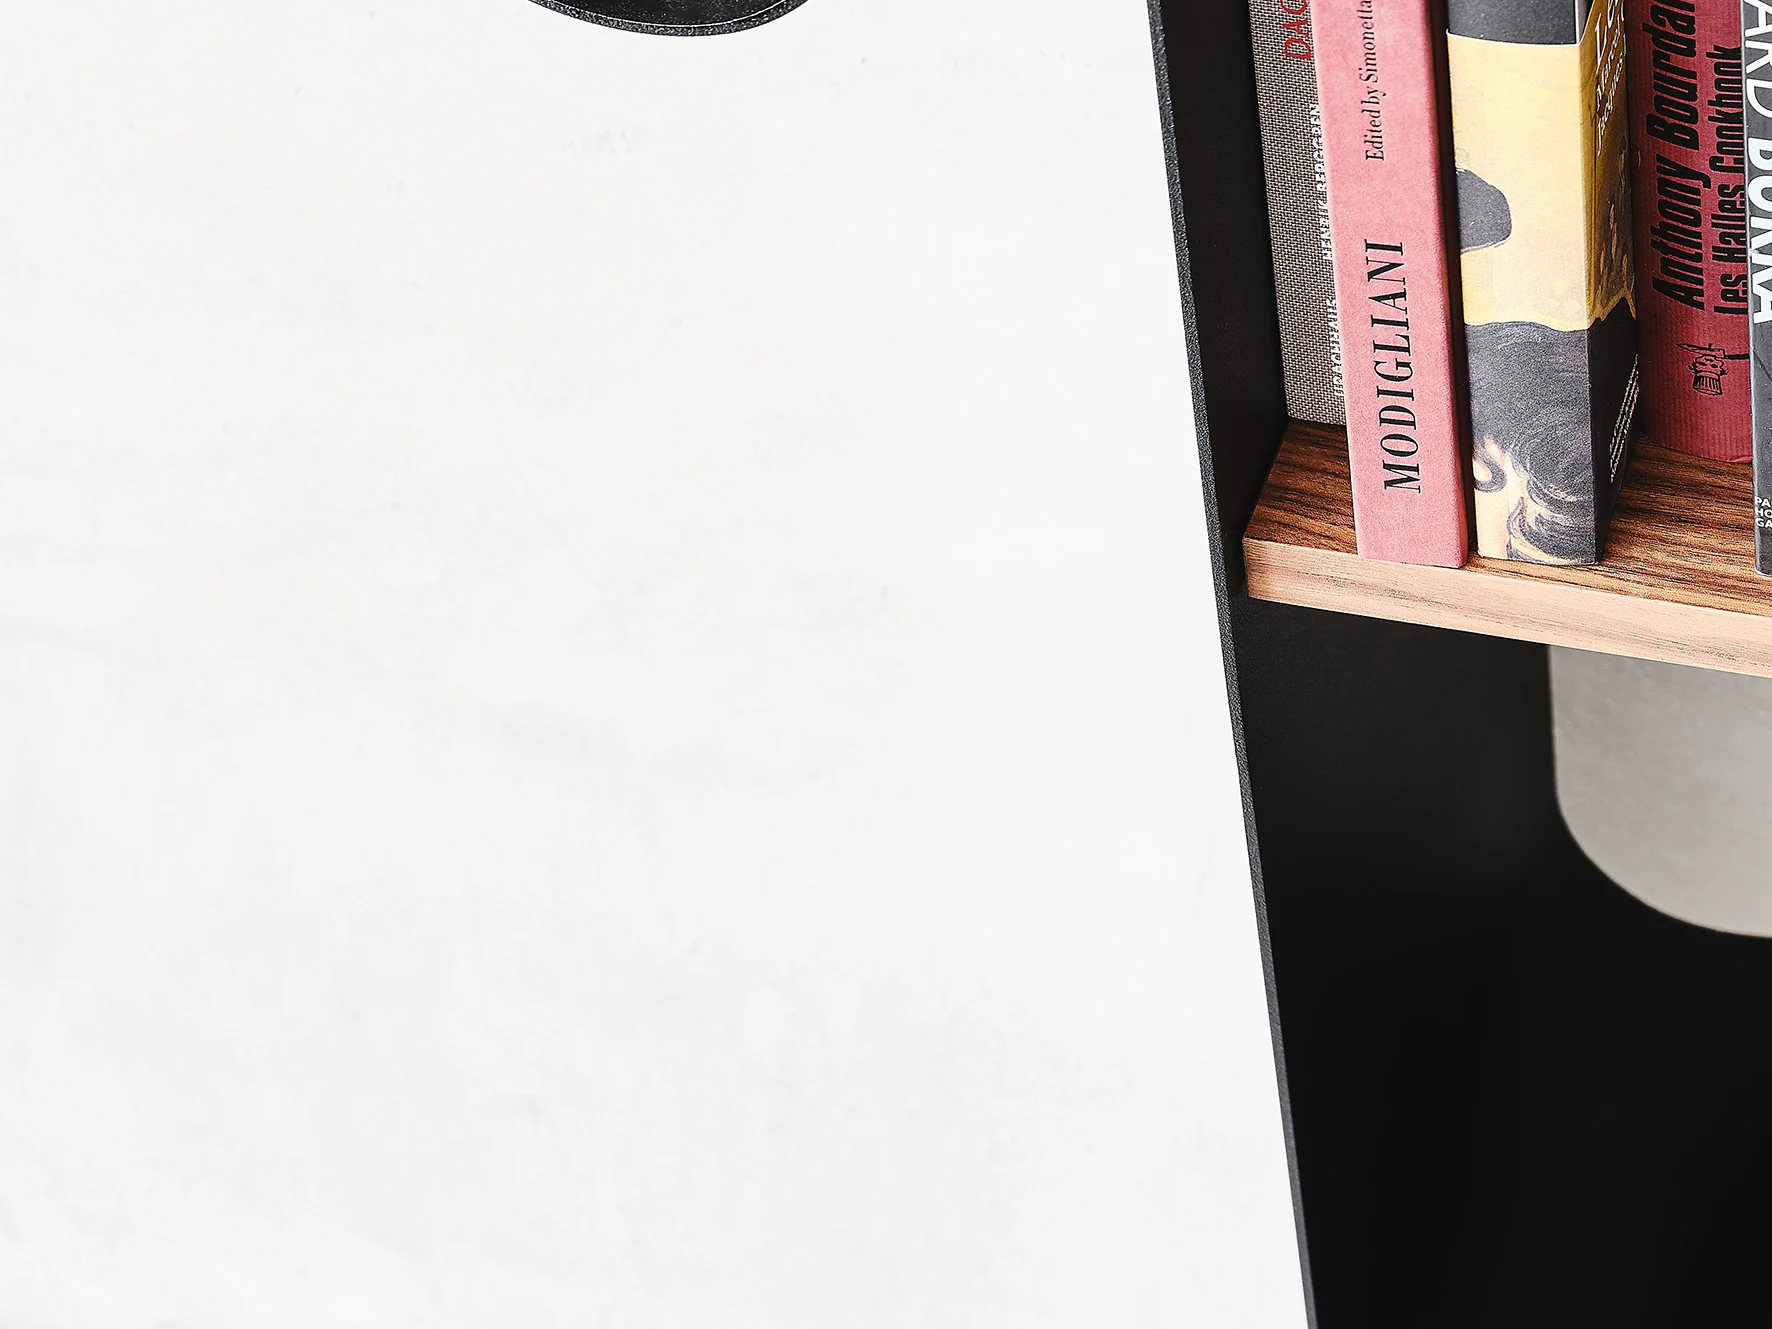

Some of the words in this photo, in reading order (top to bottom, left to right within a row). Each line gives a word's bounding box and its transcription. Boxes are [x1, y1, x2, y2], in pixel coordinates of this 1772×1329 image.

[1356, 0, 1379, 83] Simonetta
[1361, 84, 1387, 105] by
[1362, 106, 1385, 161] Edited
[1706, 44, 1745, 174] Cookbook
[1650, 154, 1711, 312] Anthony
[1710, 183, 1747, 265] Halles
[1713, 274, 1748, 316] Les
[1364, 238, 1421, 494] MODIGLIANI
